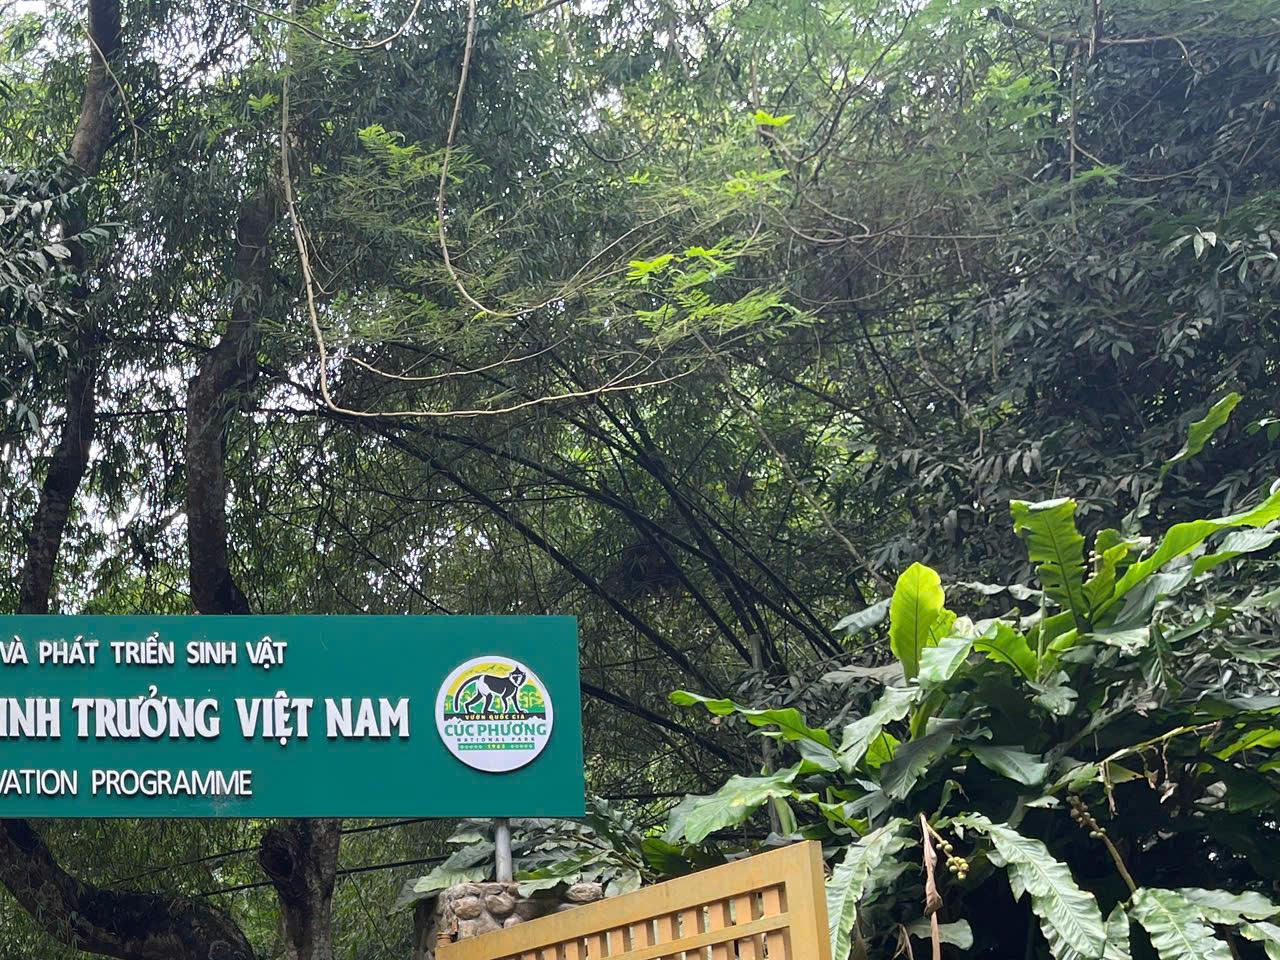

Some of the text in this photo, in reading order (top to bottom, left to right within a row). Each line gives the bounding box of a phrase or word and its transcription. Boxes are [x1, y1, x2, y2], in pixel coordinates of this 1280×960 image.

[39, 635, 100, 665] PHÁT
[110, 631, 176, 665] TRIỂN
[186, 641, 238, 665] SINH
[246, 635, 289, 670] VẬT
[71, 684, 221, 738] TRƯỞNG
[234, 690, 315, 746] VIỆT
[324, 697, 411, 738] NAM
[444, 719, 547, 737] CÚC PHƯƠNG
[91, 769, 254, 796] PROGRAMME
